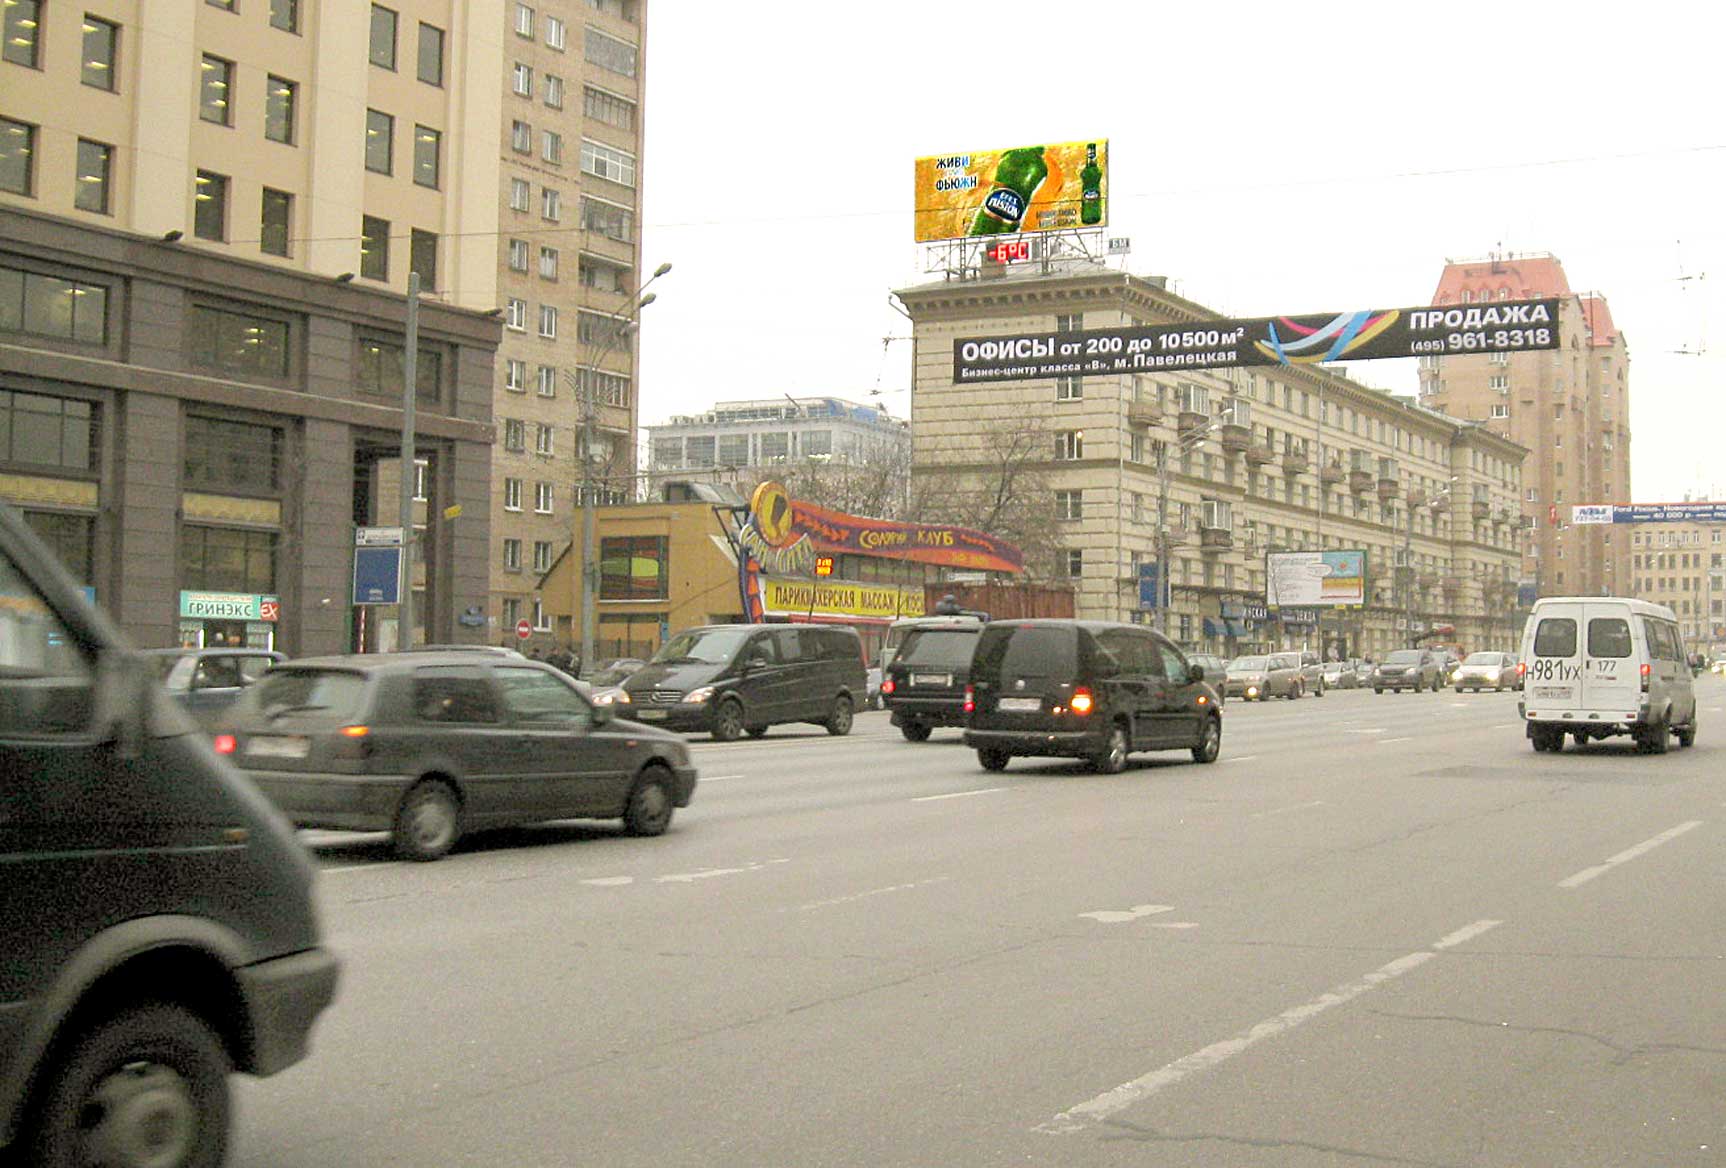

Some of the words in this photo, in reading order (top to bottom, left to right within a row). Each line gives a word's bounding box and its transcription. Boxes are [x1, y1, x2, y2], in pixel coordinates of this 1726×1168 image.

[936, 156, 969, 169] ЖИВИ
[936, 176, 977, 191] ФЬЮЖН
[1410, 304, 1550, 329] ПРОДАЖА
[1411, 339, 1445, 352] (495)
[1448, 328, 1551, 350] 961-8318
[962, 338, 1056, 361] ОФИСЫ
[1061, 343, 1082, 355] от
[1086, 338, 1122, 354] 200
[1127, 338, 1152, 353] до
[962, 366, 1037, 378] Бизнес-центр
[1041, 363, 1081, 373] класса
[775, 586, 855, 609] ПАРИКМАХЕРСКАЯ
[189, 602, 252, 616] ГРИНЭКС
[1598, 660, 1617, 672] 177
